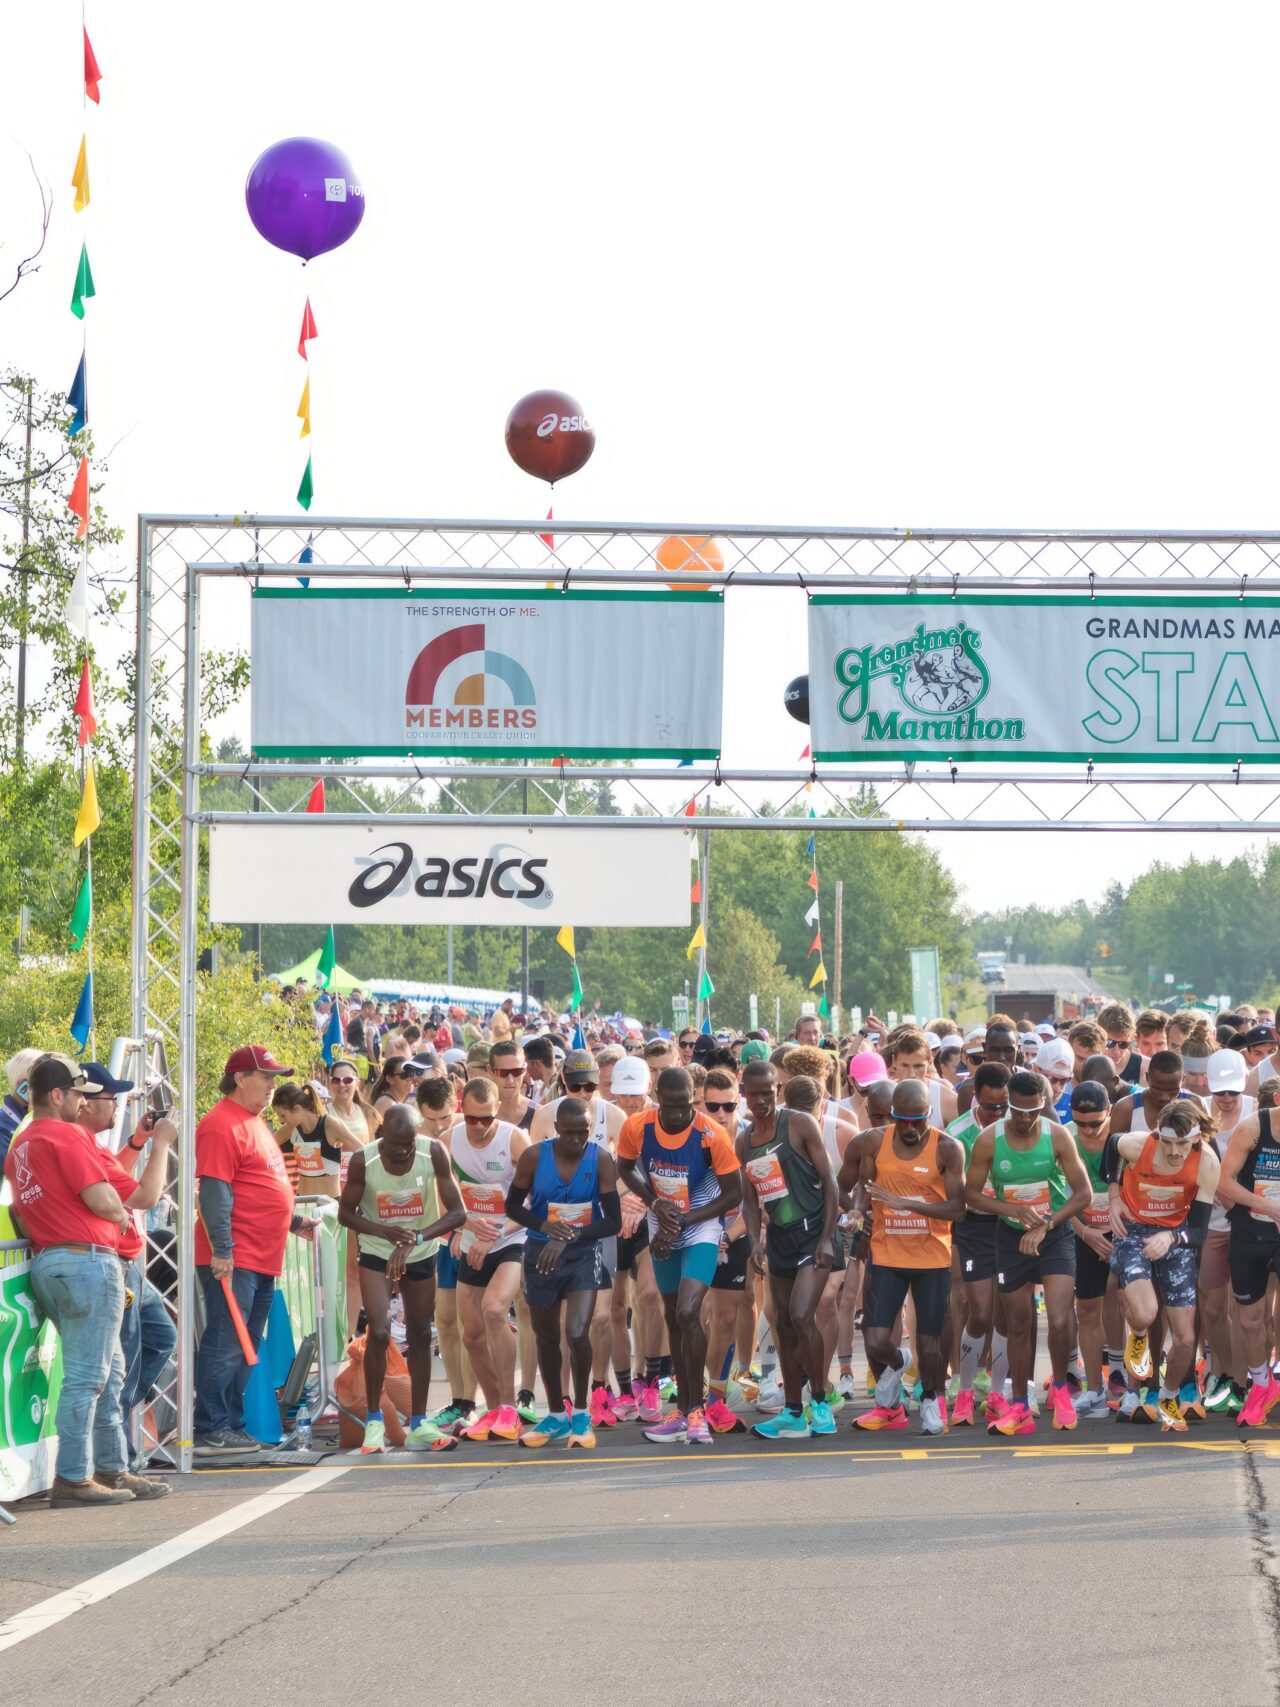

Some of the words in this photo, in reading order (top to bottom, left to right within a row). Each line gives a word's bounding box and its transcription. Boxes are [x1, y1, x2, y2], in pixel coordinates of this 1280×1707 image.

[405, 606, 429, 616] THE
[432, 606, 496, 617] STRENGTH
[499, 607, 516, 617] OF
[519, 607, 540, 617] ME.
[1085, 617, 1235, 640] GRANDMAS
[405, 708, 537, 728] MEMBERS
[862, 708, 1026, 743] Marathon
